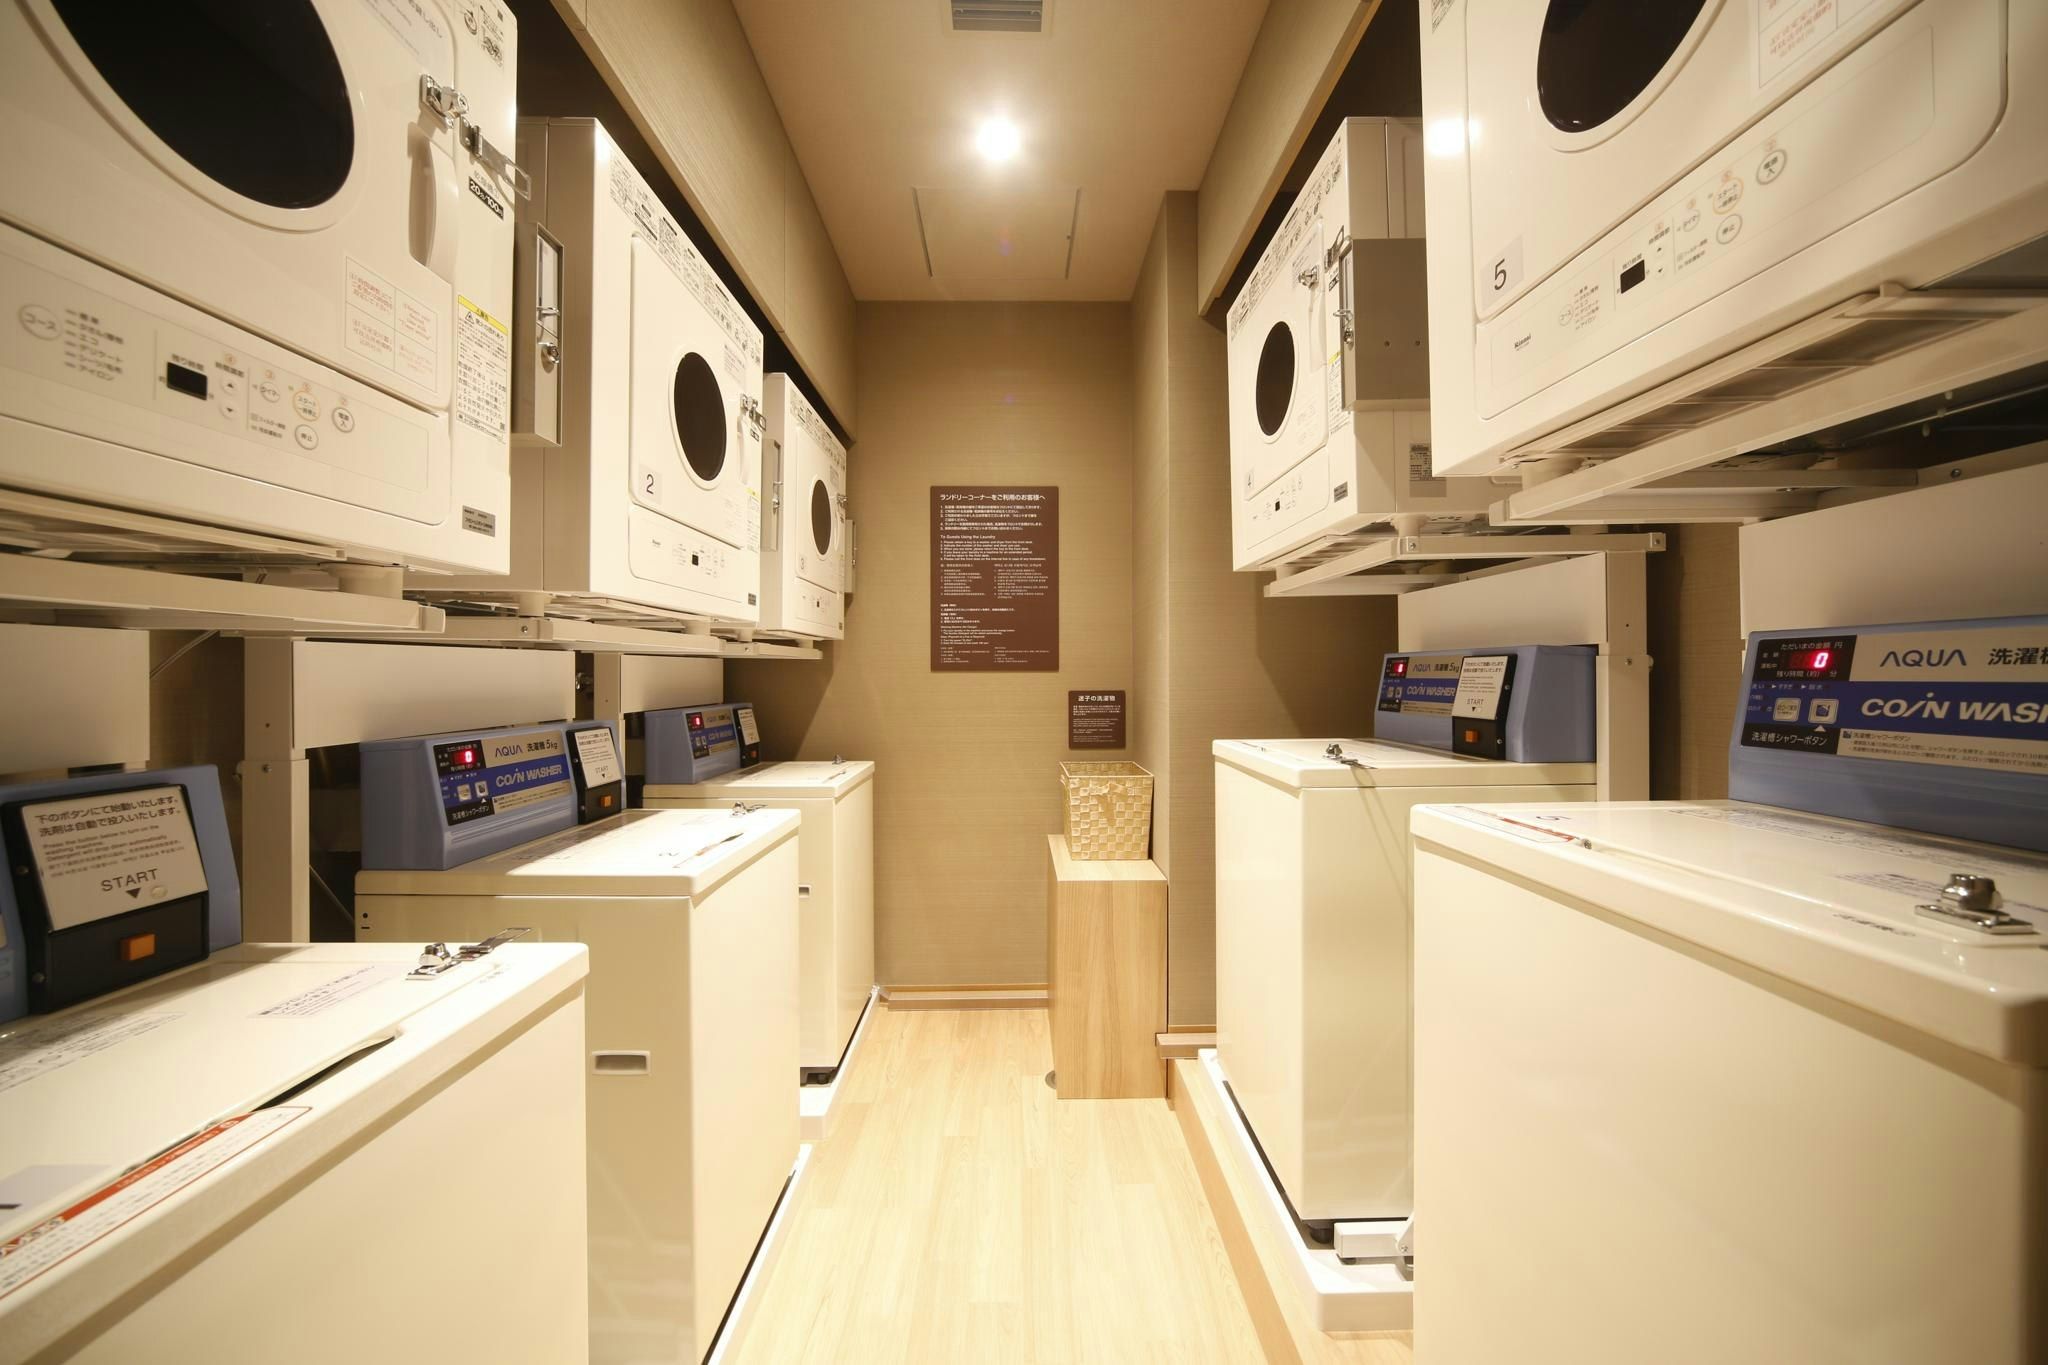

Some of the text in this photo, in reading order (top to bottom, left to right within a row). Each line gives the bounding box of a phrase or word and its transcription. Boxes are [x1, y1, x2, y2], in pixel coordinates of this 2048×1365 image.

[1494, 258, 1507, 290] 5
[646, 473, 654, 494] 2
[1814, 652, 1829, 668] 0
[1426, 687, 1456, 697] WASHER
[495, 744, 523, 757] AQUA
[526, 764, 562, 780] WASHER
[101, 868, 158, 891] START
